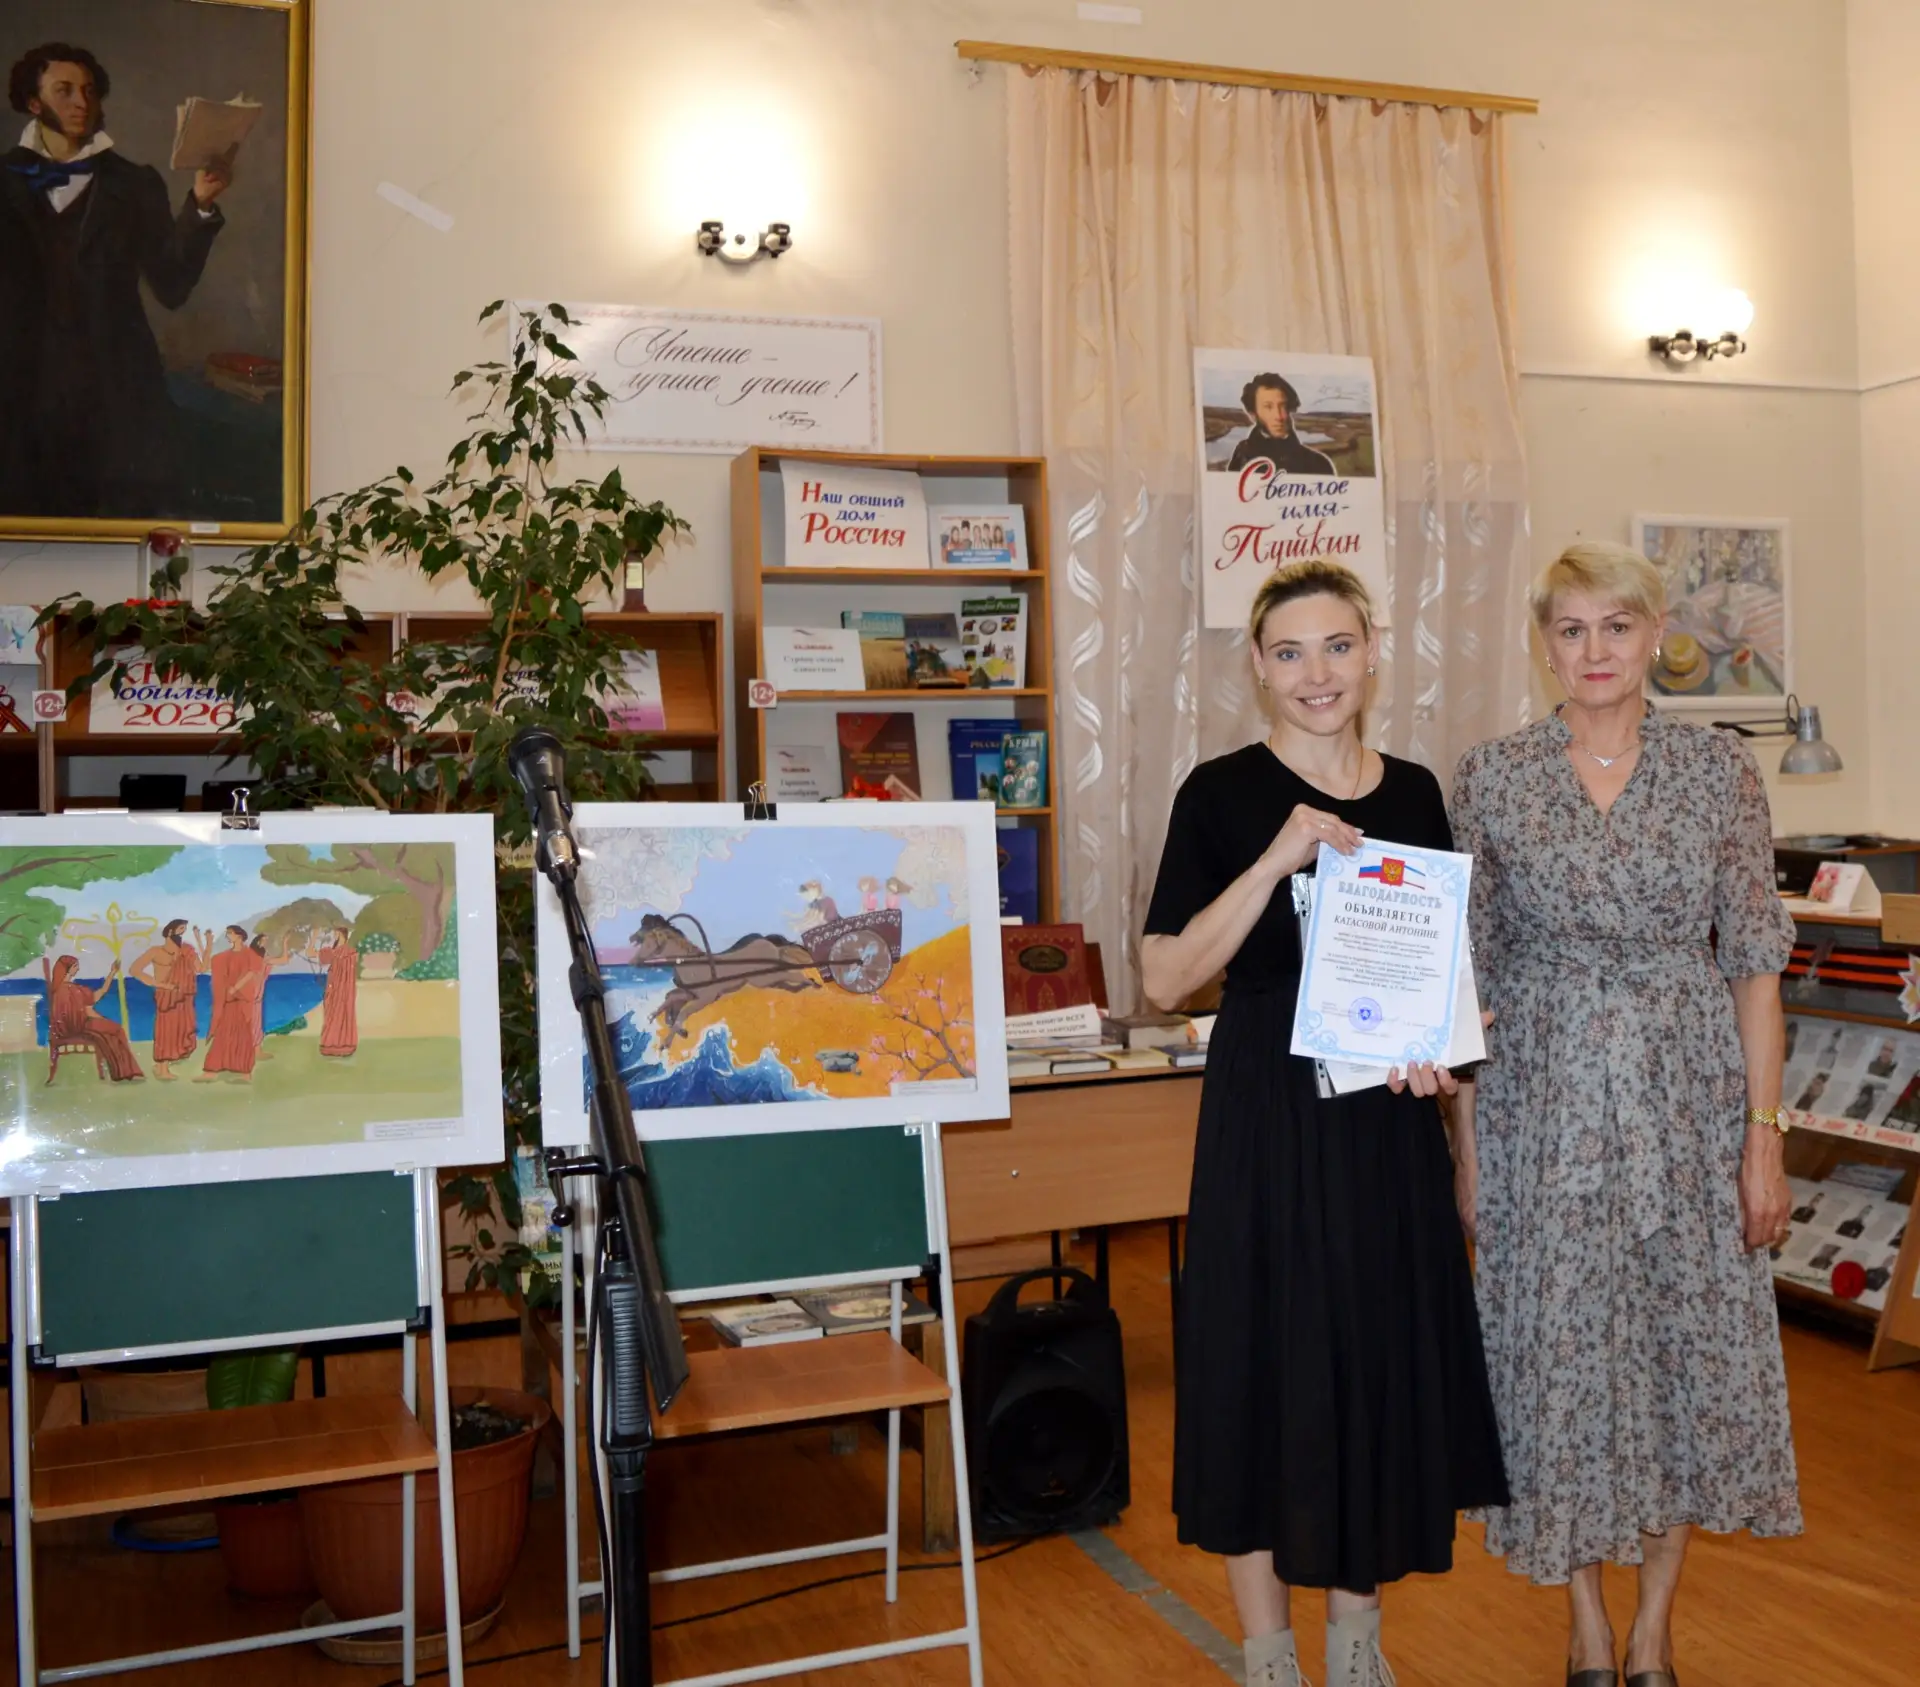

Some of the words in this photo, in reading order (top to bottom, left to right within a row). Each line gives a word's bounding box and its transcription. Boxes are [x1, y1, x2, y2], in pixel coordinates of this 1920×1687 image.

[1238, 459, 1350, 503] Светлое
[1214, 519, 1361, 571] Пушкин
[36, 698, 65, 713] 12+
[752, 686, 775, 700] 12+
[123, 702, 235, 727] 2026
[1338, 881, 1443, 909] БЛАГОДАРНОСТЬ
[1344, 902, 1431, 925] ОБЪЯВЛЯЕТСЯ
[1334, 914, 1388, 932] КАТАСОВОЙ
[1388, 924, 1441, 940] АНТОНИНЕ
